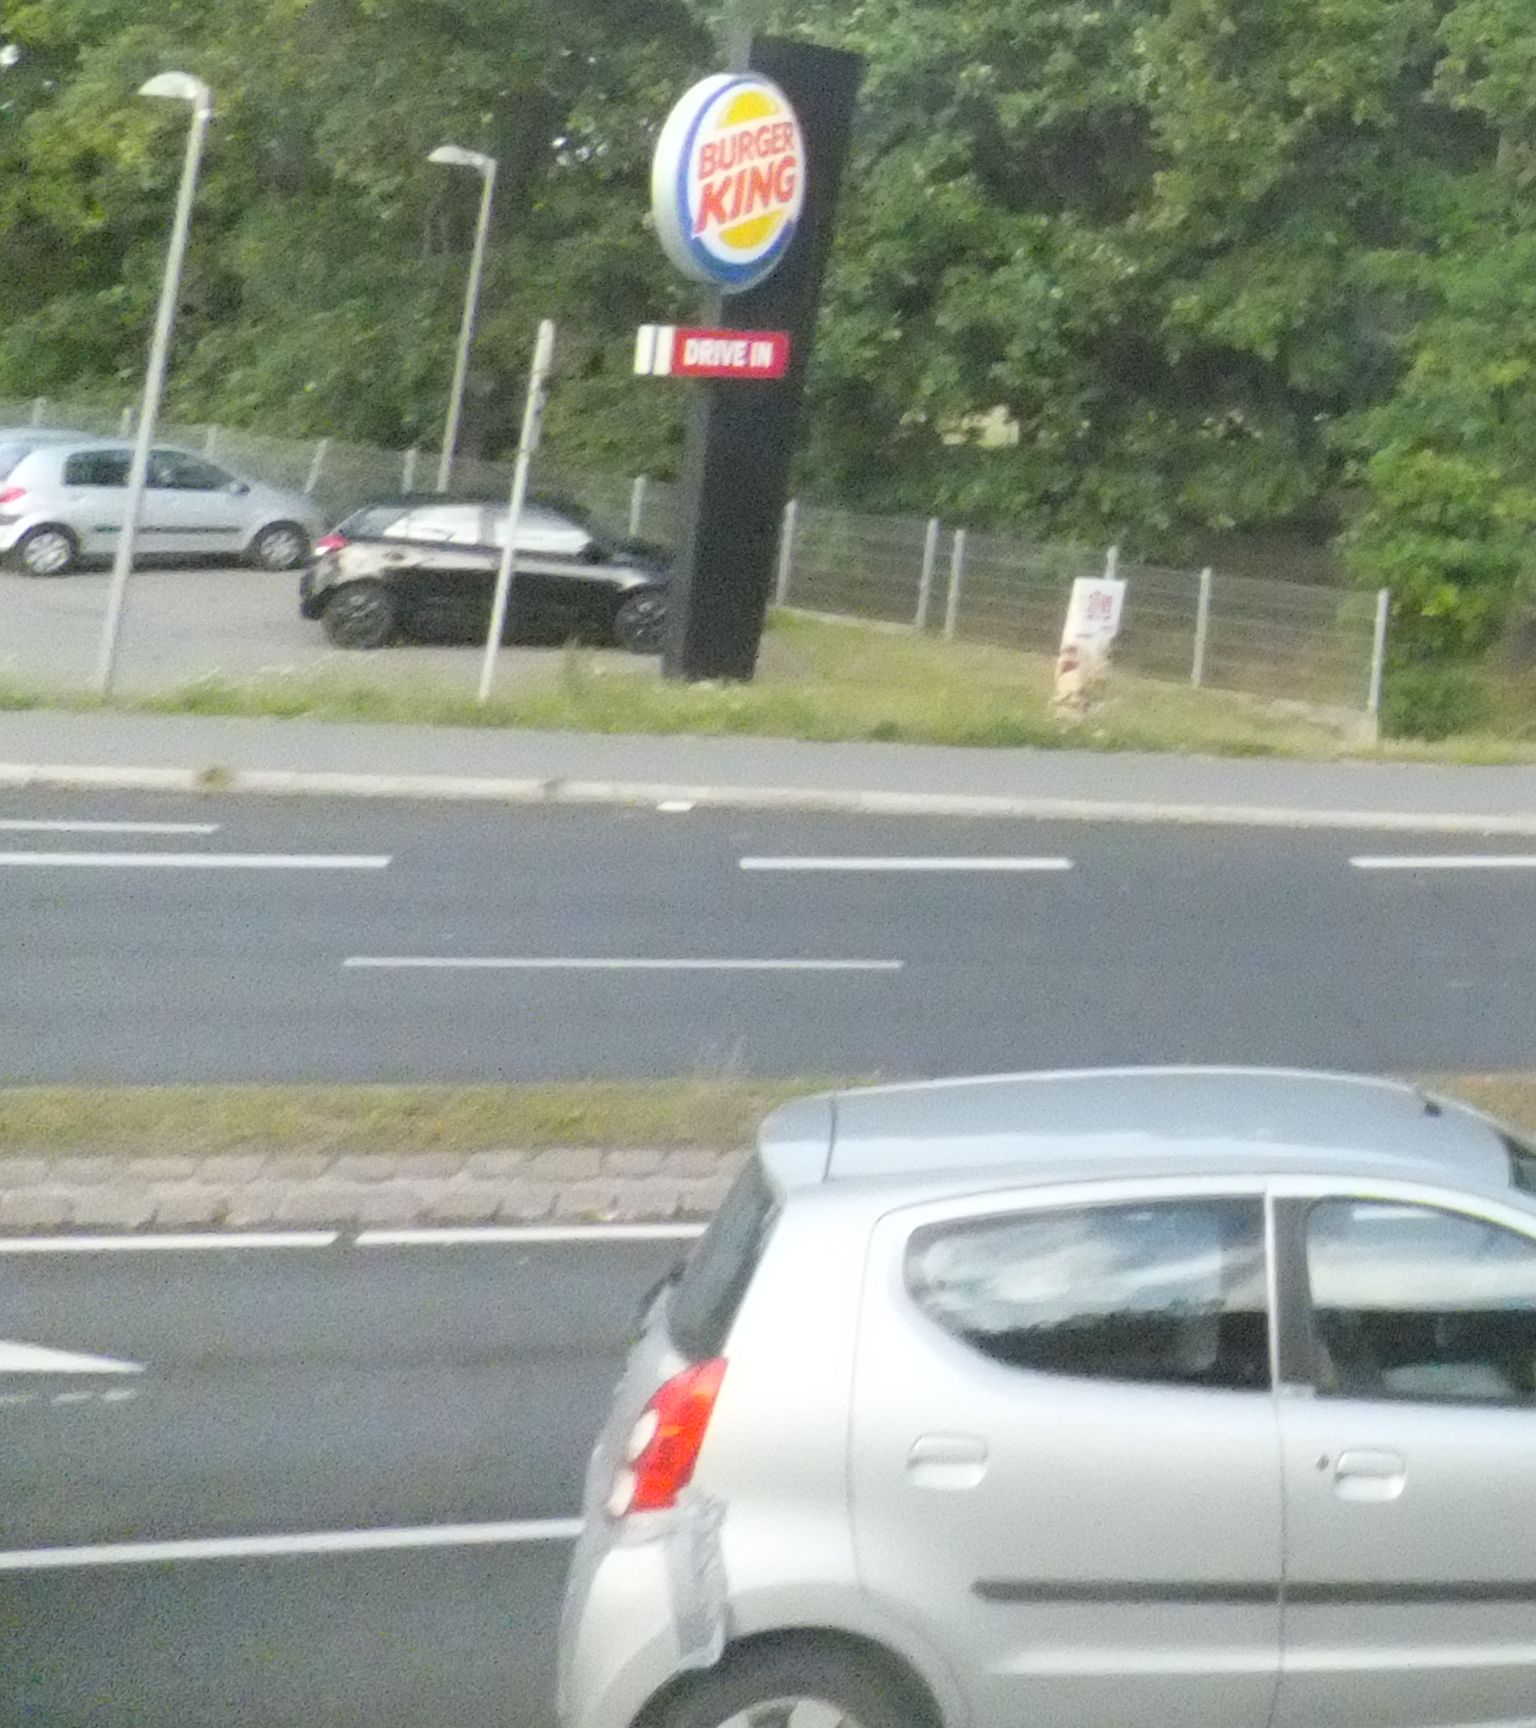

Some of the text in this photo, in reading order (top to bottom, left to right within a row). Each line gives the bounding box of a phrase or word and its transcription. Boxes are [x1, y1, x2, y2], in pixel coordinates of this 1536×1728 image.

[698, 122, 795, 179] BURGER
[695, 157, 796, 233] KING
[683, 338, 774, 368] DRIVE IN
